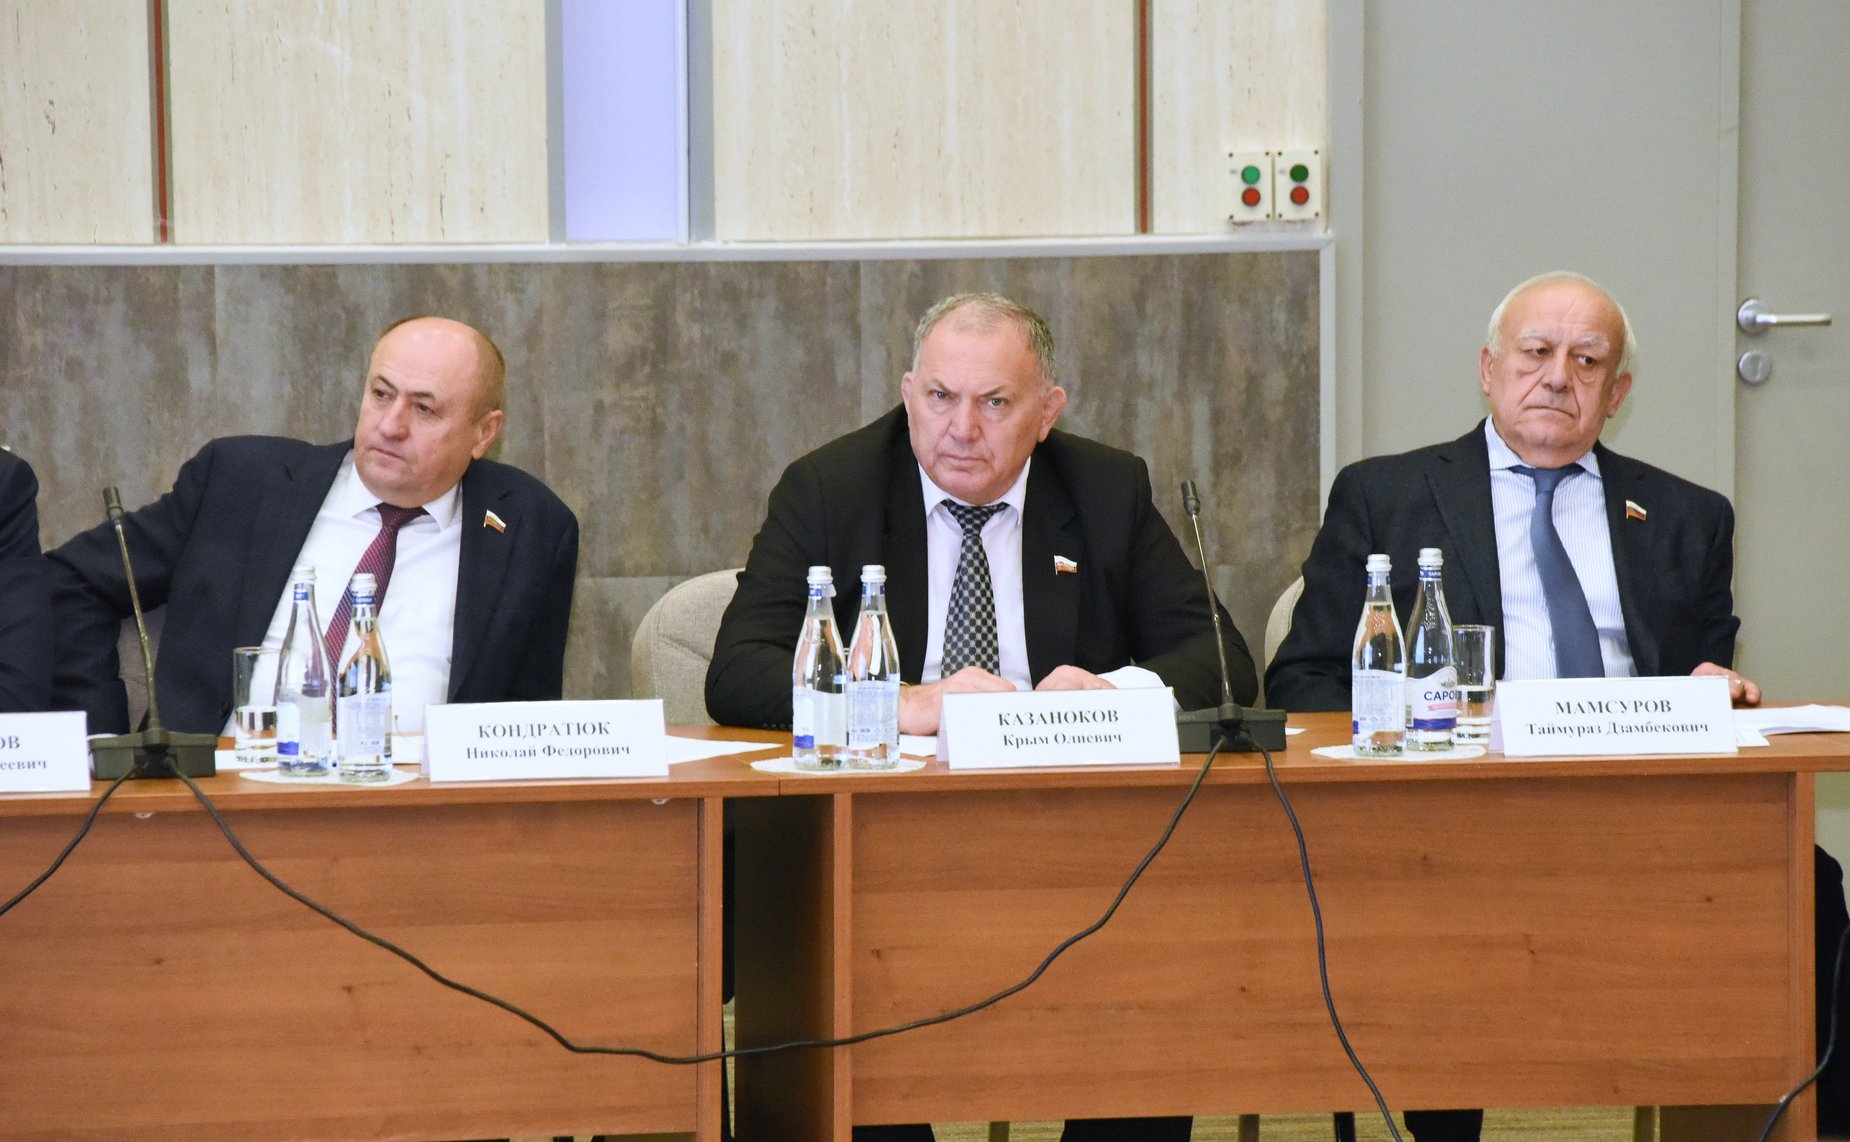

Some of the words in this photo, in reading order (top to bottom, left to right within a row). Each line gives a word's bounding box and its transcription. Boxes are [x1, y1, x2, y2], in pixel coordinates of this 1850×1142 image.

[1423, 690, 1457, 701] САРО
[1555, 699, 1672, 715] МАМСУРОВ
[998, 709, 1119, 727] КАЗАНОКОВ
[478, 721, 610, 740] КОНДРАТЮК
[1526, 722, 1602, 738] Таймураз
[1606, 720, 1709, 736] Дзамбекович
[1003, 734, 1049, 750] Крым
[1054, 732, 1122, 745] Олиевич
[466, 746, 537, 760] Николай
[542, 744, 631, 760] Федорович
